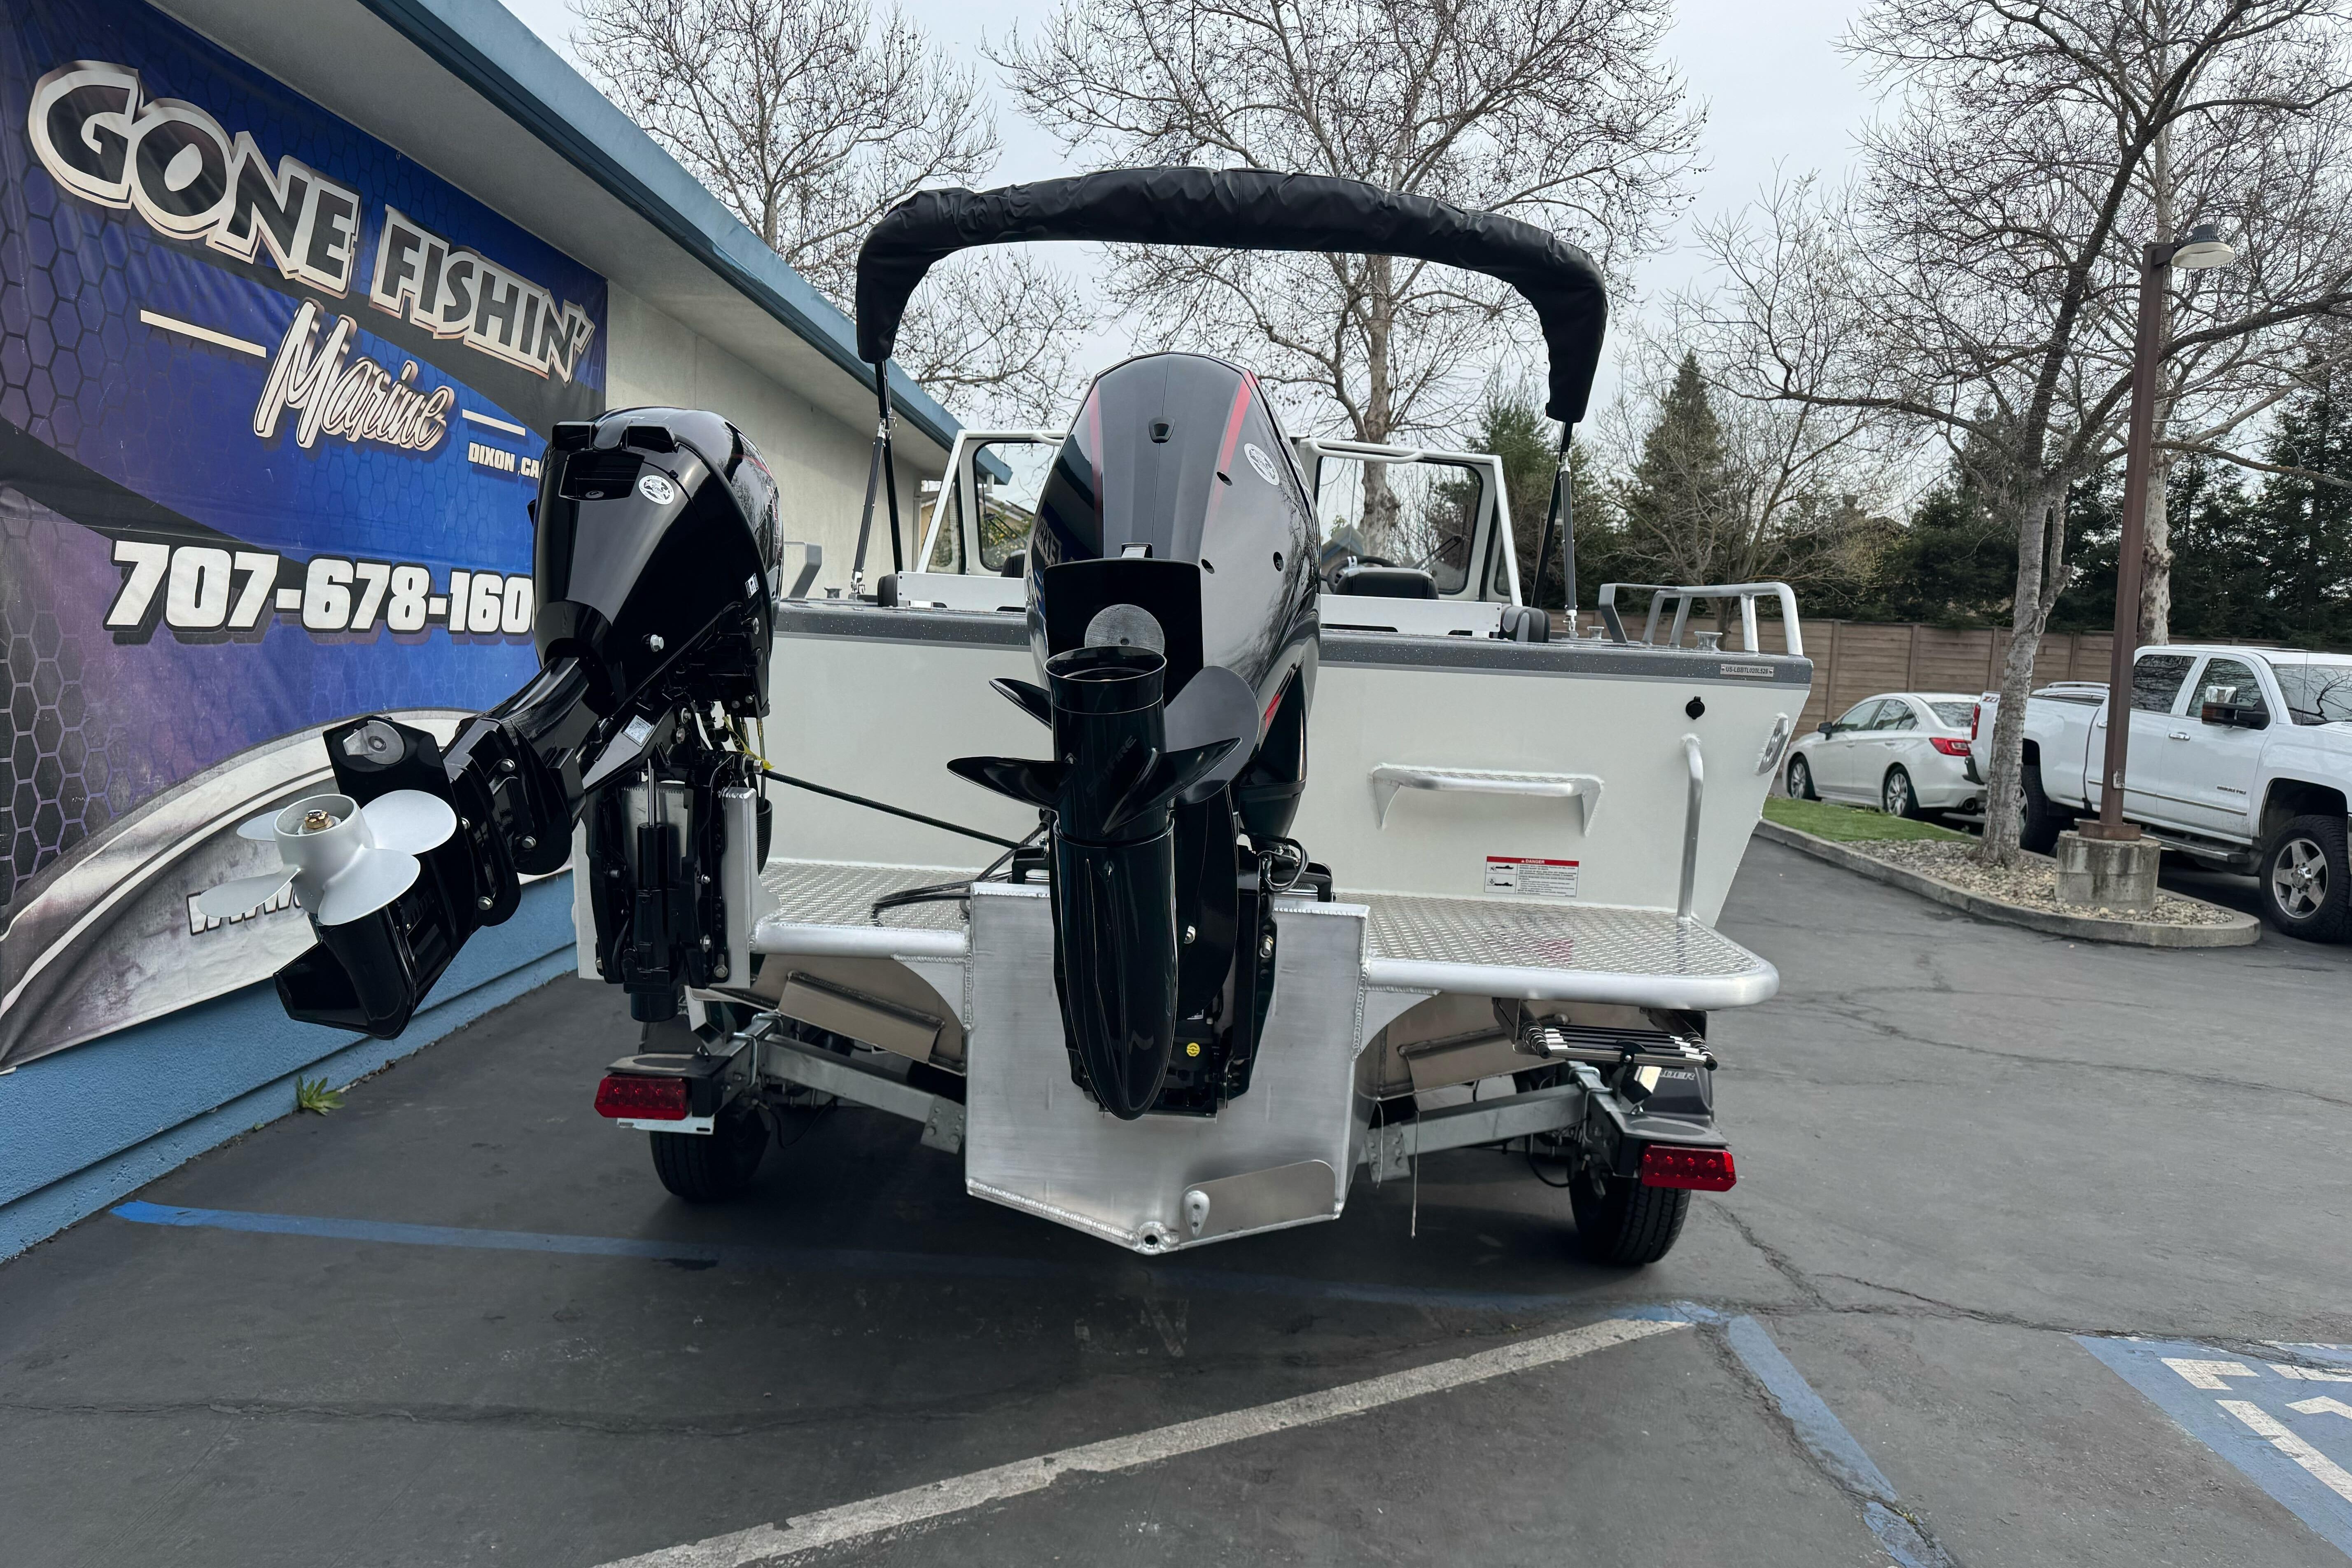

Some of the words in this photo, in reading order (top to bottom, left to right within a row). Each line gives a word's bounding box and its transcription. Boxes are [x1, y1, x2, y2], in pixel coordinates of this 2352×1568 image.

[30, 61, 362, 298] GONE
[254, 297, 454, 451] Marine
[468, 442, 515, 472] DIXON
[105, 540, 534, 633] 707-678-160
